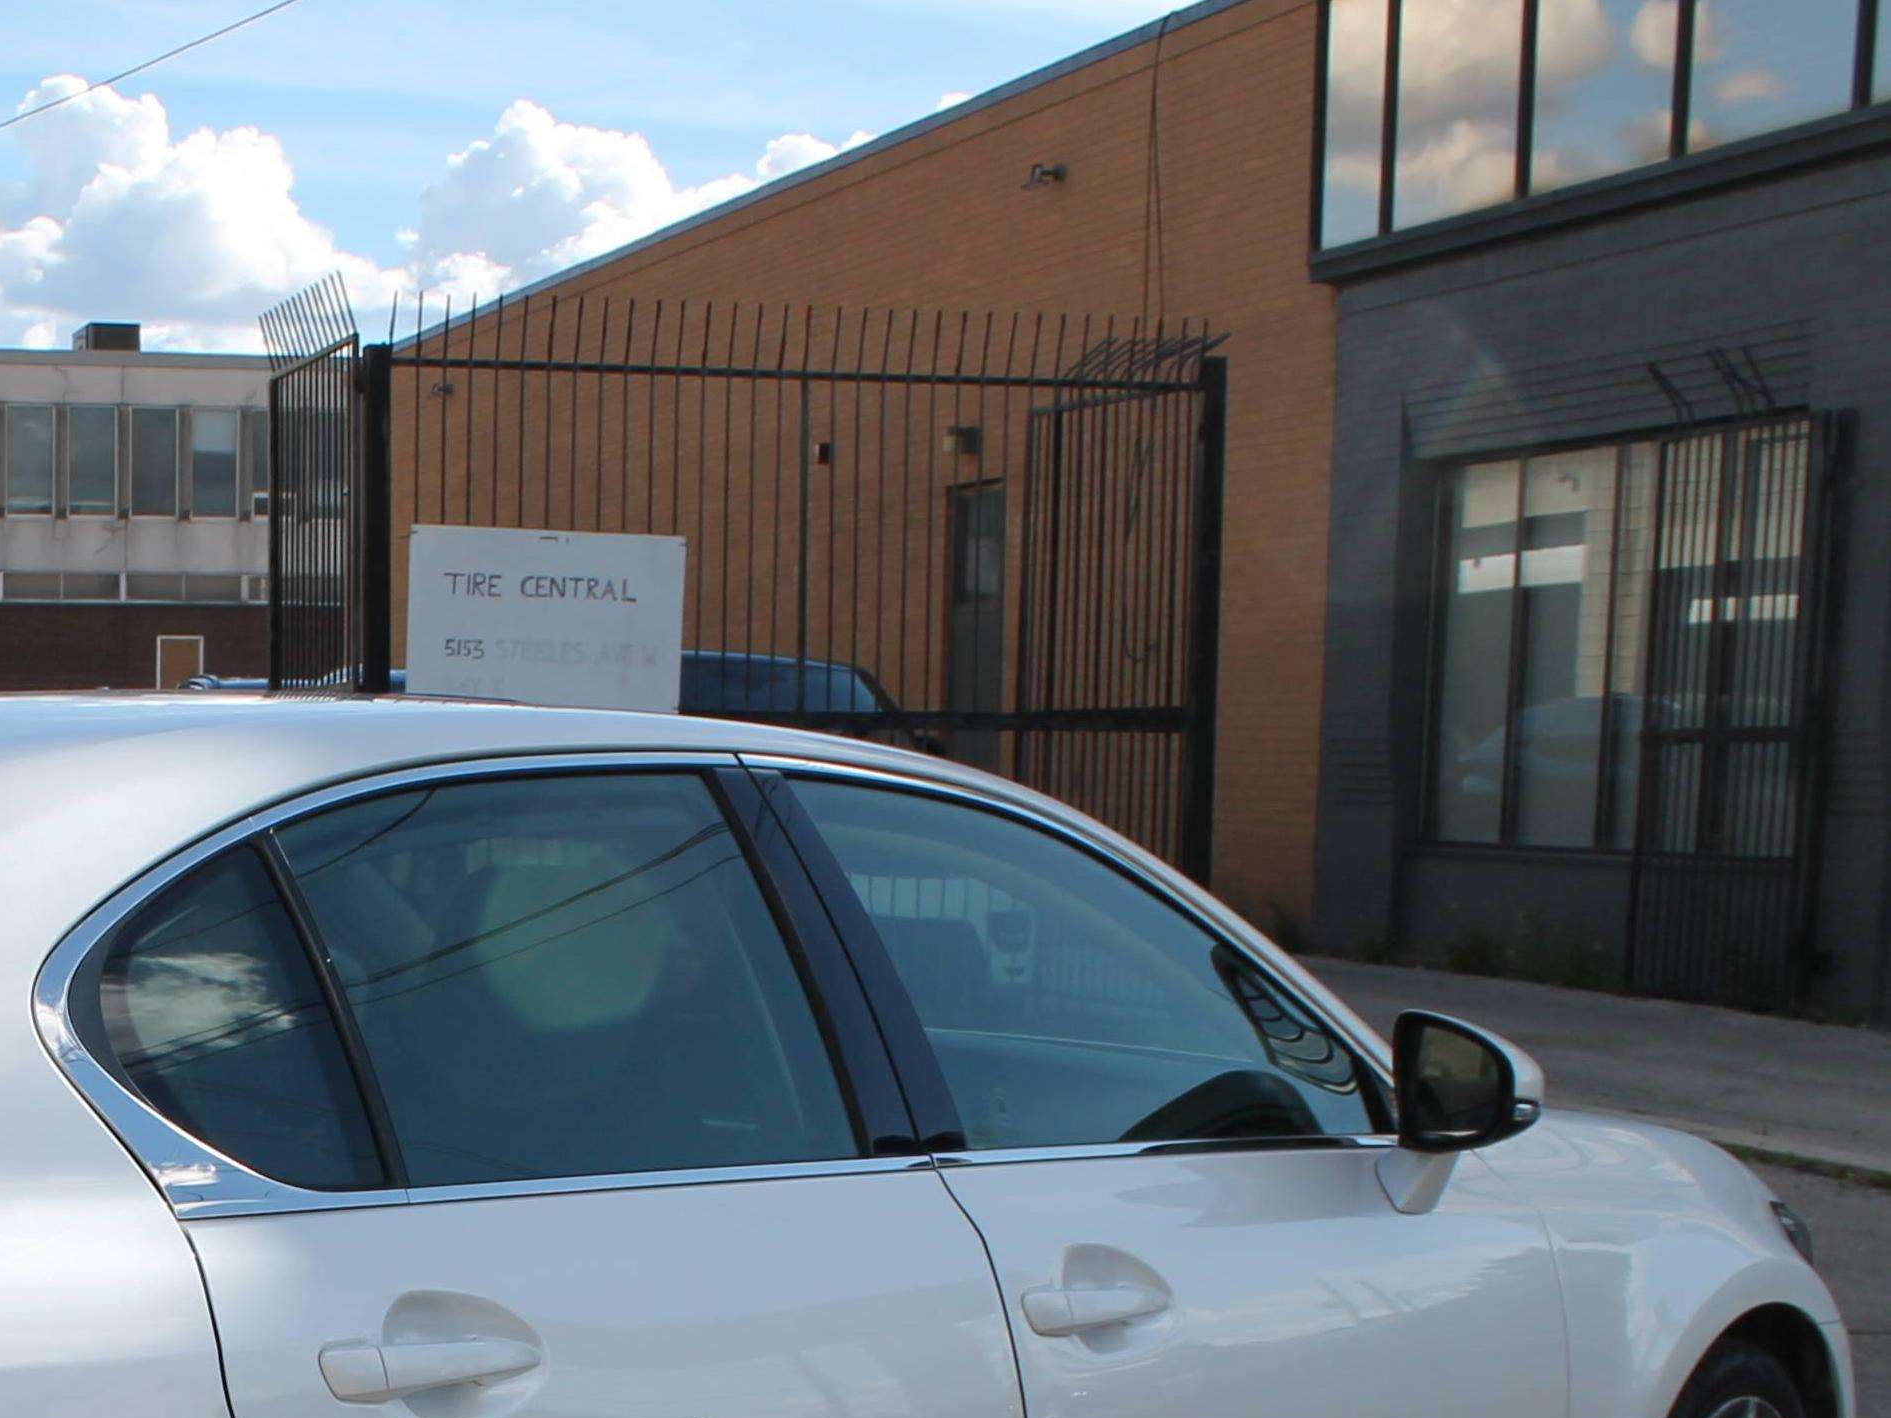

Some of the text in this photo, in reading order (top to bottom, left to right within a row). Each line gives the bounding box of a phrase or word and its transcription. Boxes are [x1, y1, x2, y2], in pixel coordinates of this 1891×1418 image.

[444, 572, 637, 602] TIRE CENTRAL
[444, 638, 485, 660] 5153
